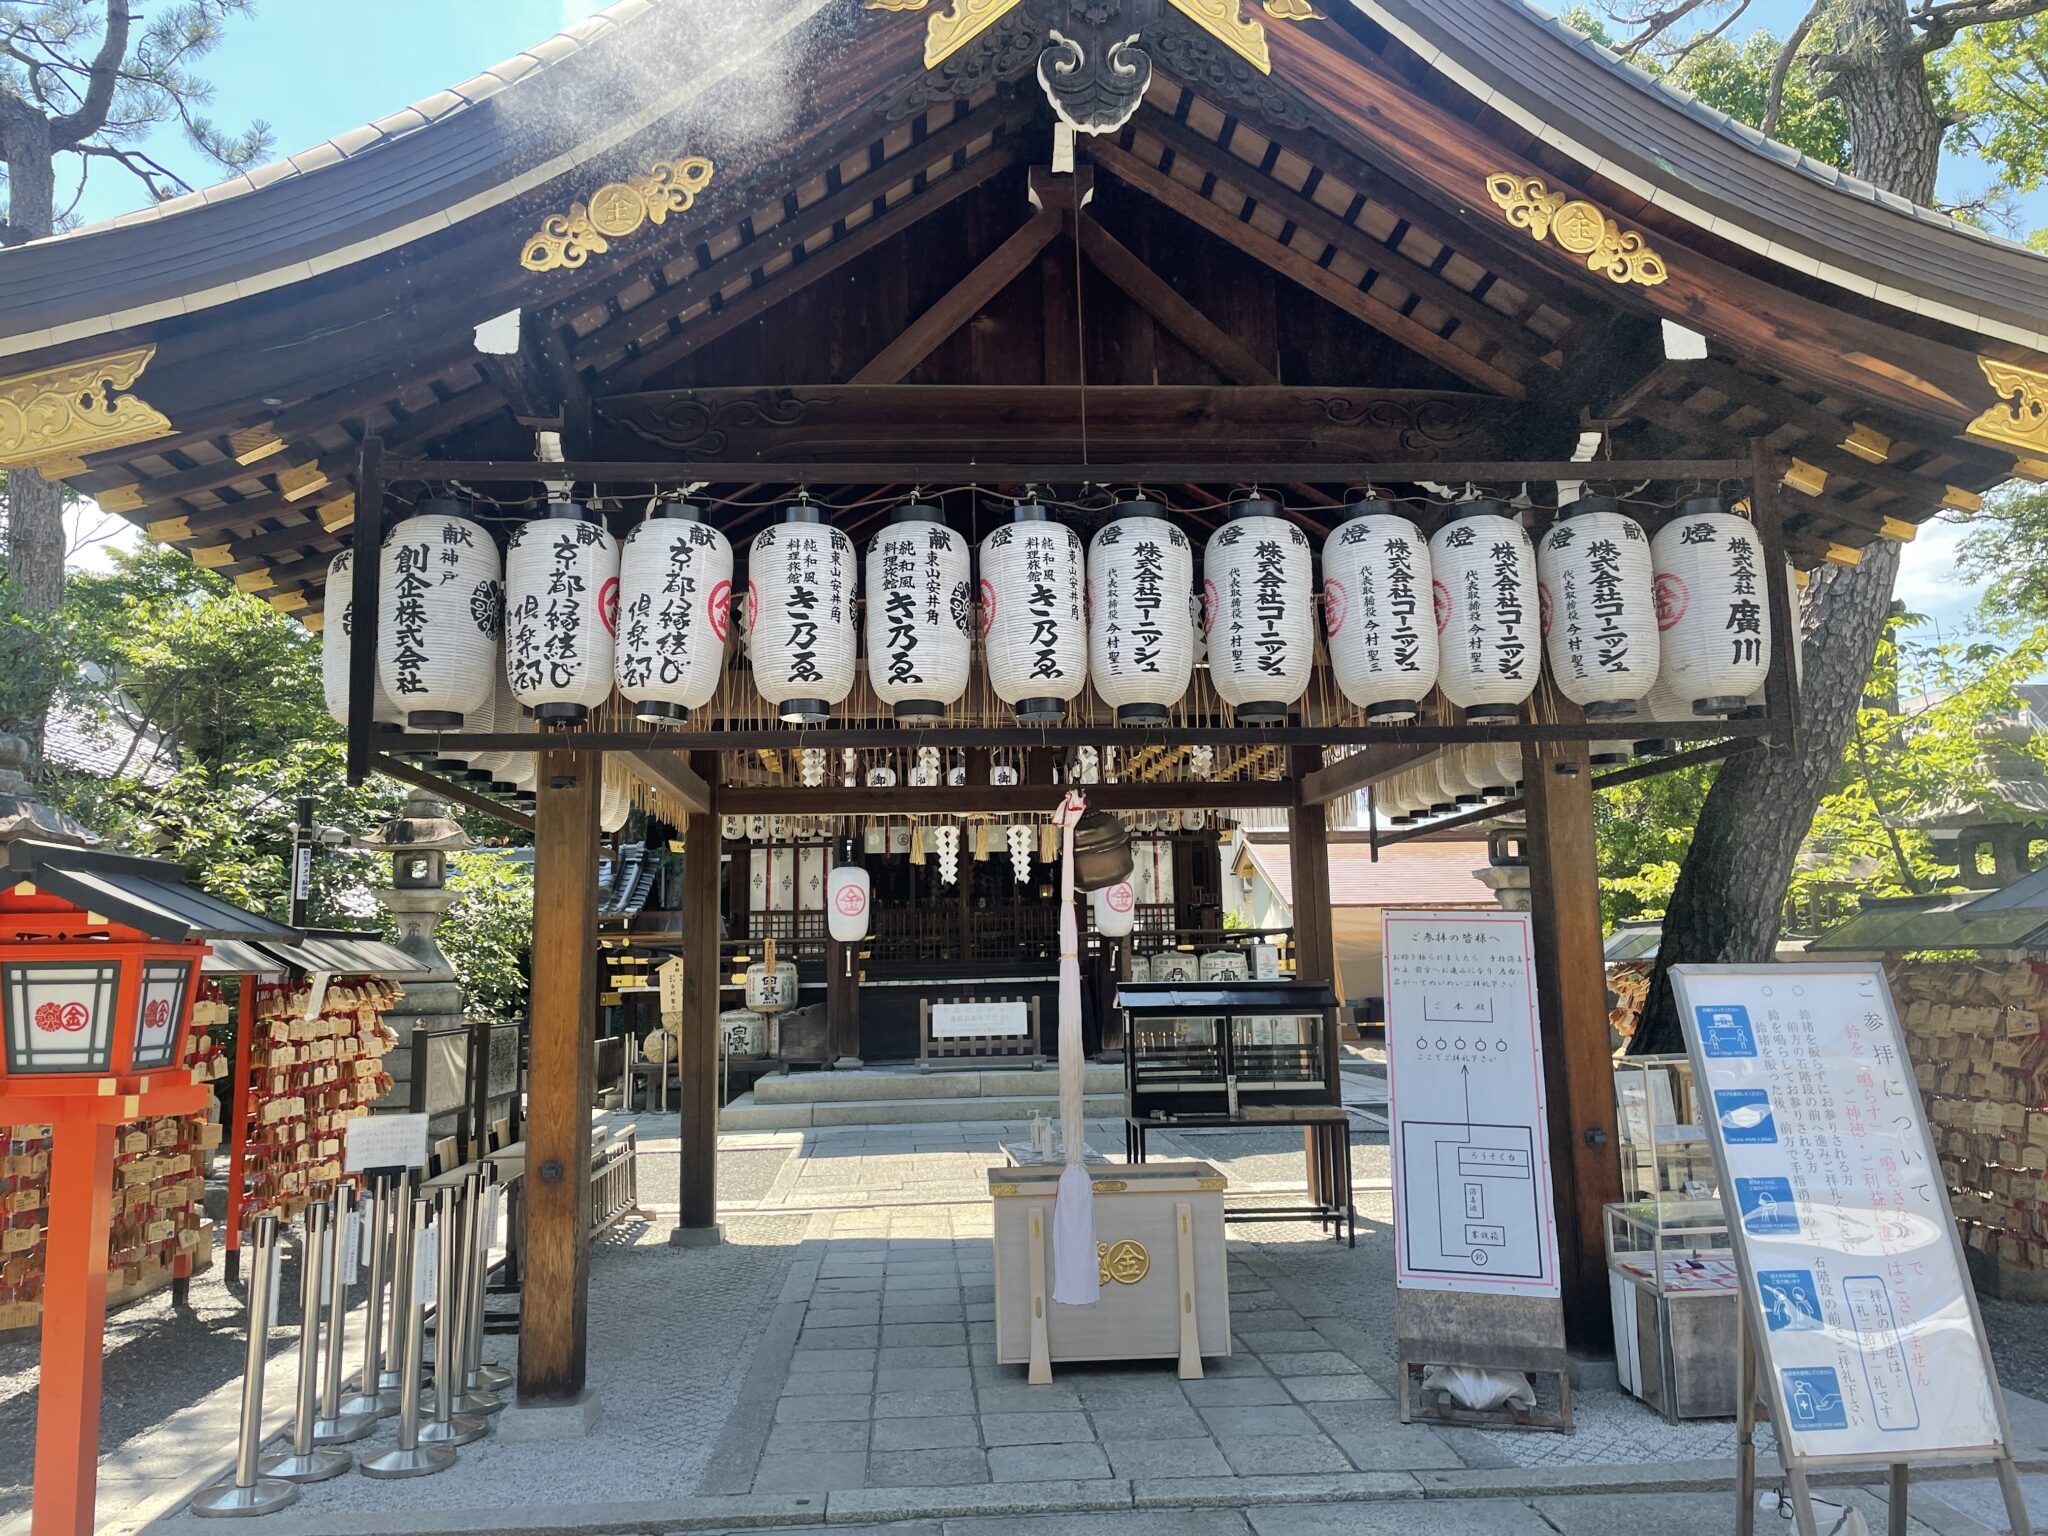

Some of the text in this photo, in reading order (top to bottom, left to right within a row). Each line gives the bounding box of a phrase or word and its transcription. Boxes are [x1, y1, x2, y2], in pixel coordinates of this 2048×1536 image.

[1563, 207, 1598, 240] 金
[442, 523, 474, 548] 献
[575, 523, 607, 550] 献
[689, 524, 717, 551] 献
[829, 528, 850, 553] 献
[927, 527, 953, 552] 献
[1097, 525, 1124, 547] 燈
[1216, 524, 1247, 547] 燈
[1338, 523, 1372, 546] 燈
[1446, 526, 1477, 549] 燈
[1547, 526, 1577, 551] 燈
[1680, 522, 1718, 546] 燈
[439, 548, 459, 586] 神戸
[786, 538, 803, 585] 料理旅館
[803, 538, 819, 586] 純和風
[882, 542, 899, 591] 料理旅館
[898, 540, 917, 589] 純和風
[1025, 536, 1042, 583] 料理旅館
[1041, 536, 1056, 583] 純和風
[829, 551, 843, 625] 東山安井角
[925, 551, 941, 626] 東山安井角
[1067, 549, 1080, 622] 東山安井角
[1130, 541, 1165, 673] 株式会社コーニッシュ
[1253, 540, 1288, 677] 株式会社コーニッシュ
[1383, 537, 1421, 672] 株式会社コーニッシュ
[1586, 538, 1630, 673] 株式会社コーニッシュ
[1726, 537, 1762, 667] 株式会社廣川
[393, 543, 433, 695] 創企株式会社
[543, 535, 586, 689] 京都縁結び
[656, 537, 700, 685] 京都縁結び
[785, 586, 824, 683] き乃ゑ
[1027, 583, 1065, 680] き乃ゑ
[1490, 541, 1526, 680] 株式会社コーニッシュ
[514, 594, 544, 691] 倶楽部
[623, 593, 653, 688] 倶楽部
[884, 591, 924, 685] き乃ゑ
[1411, 931, 1501, 944] ご参拝の皆様へ
[64, 1006, 85, 1027] 金
[157, 1003, 168, 1023] 金
[1857, 978, 1930, 1203] ご参拝について
[1113, 1243, 1146, 1278] 金
